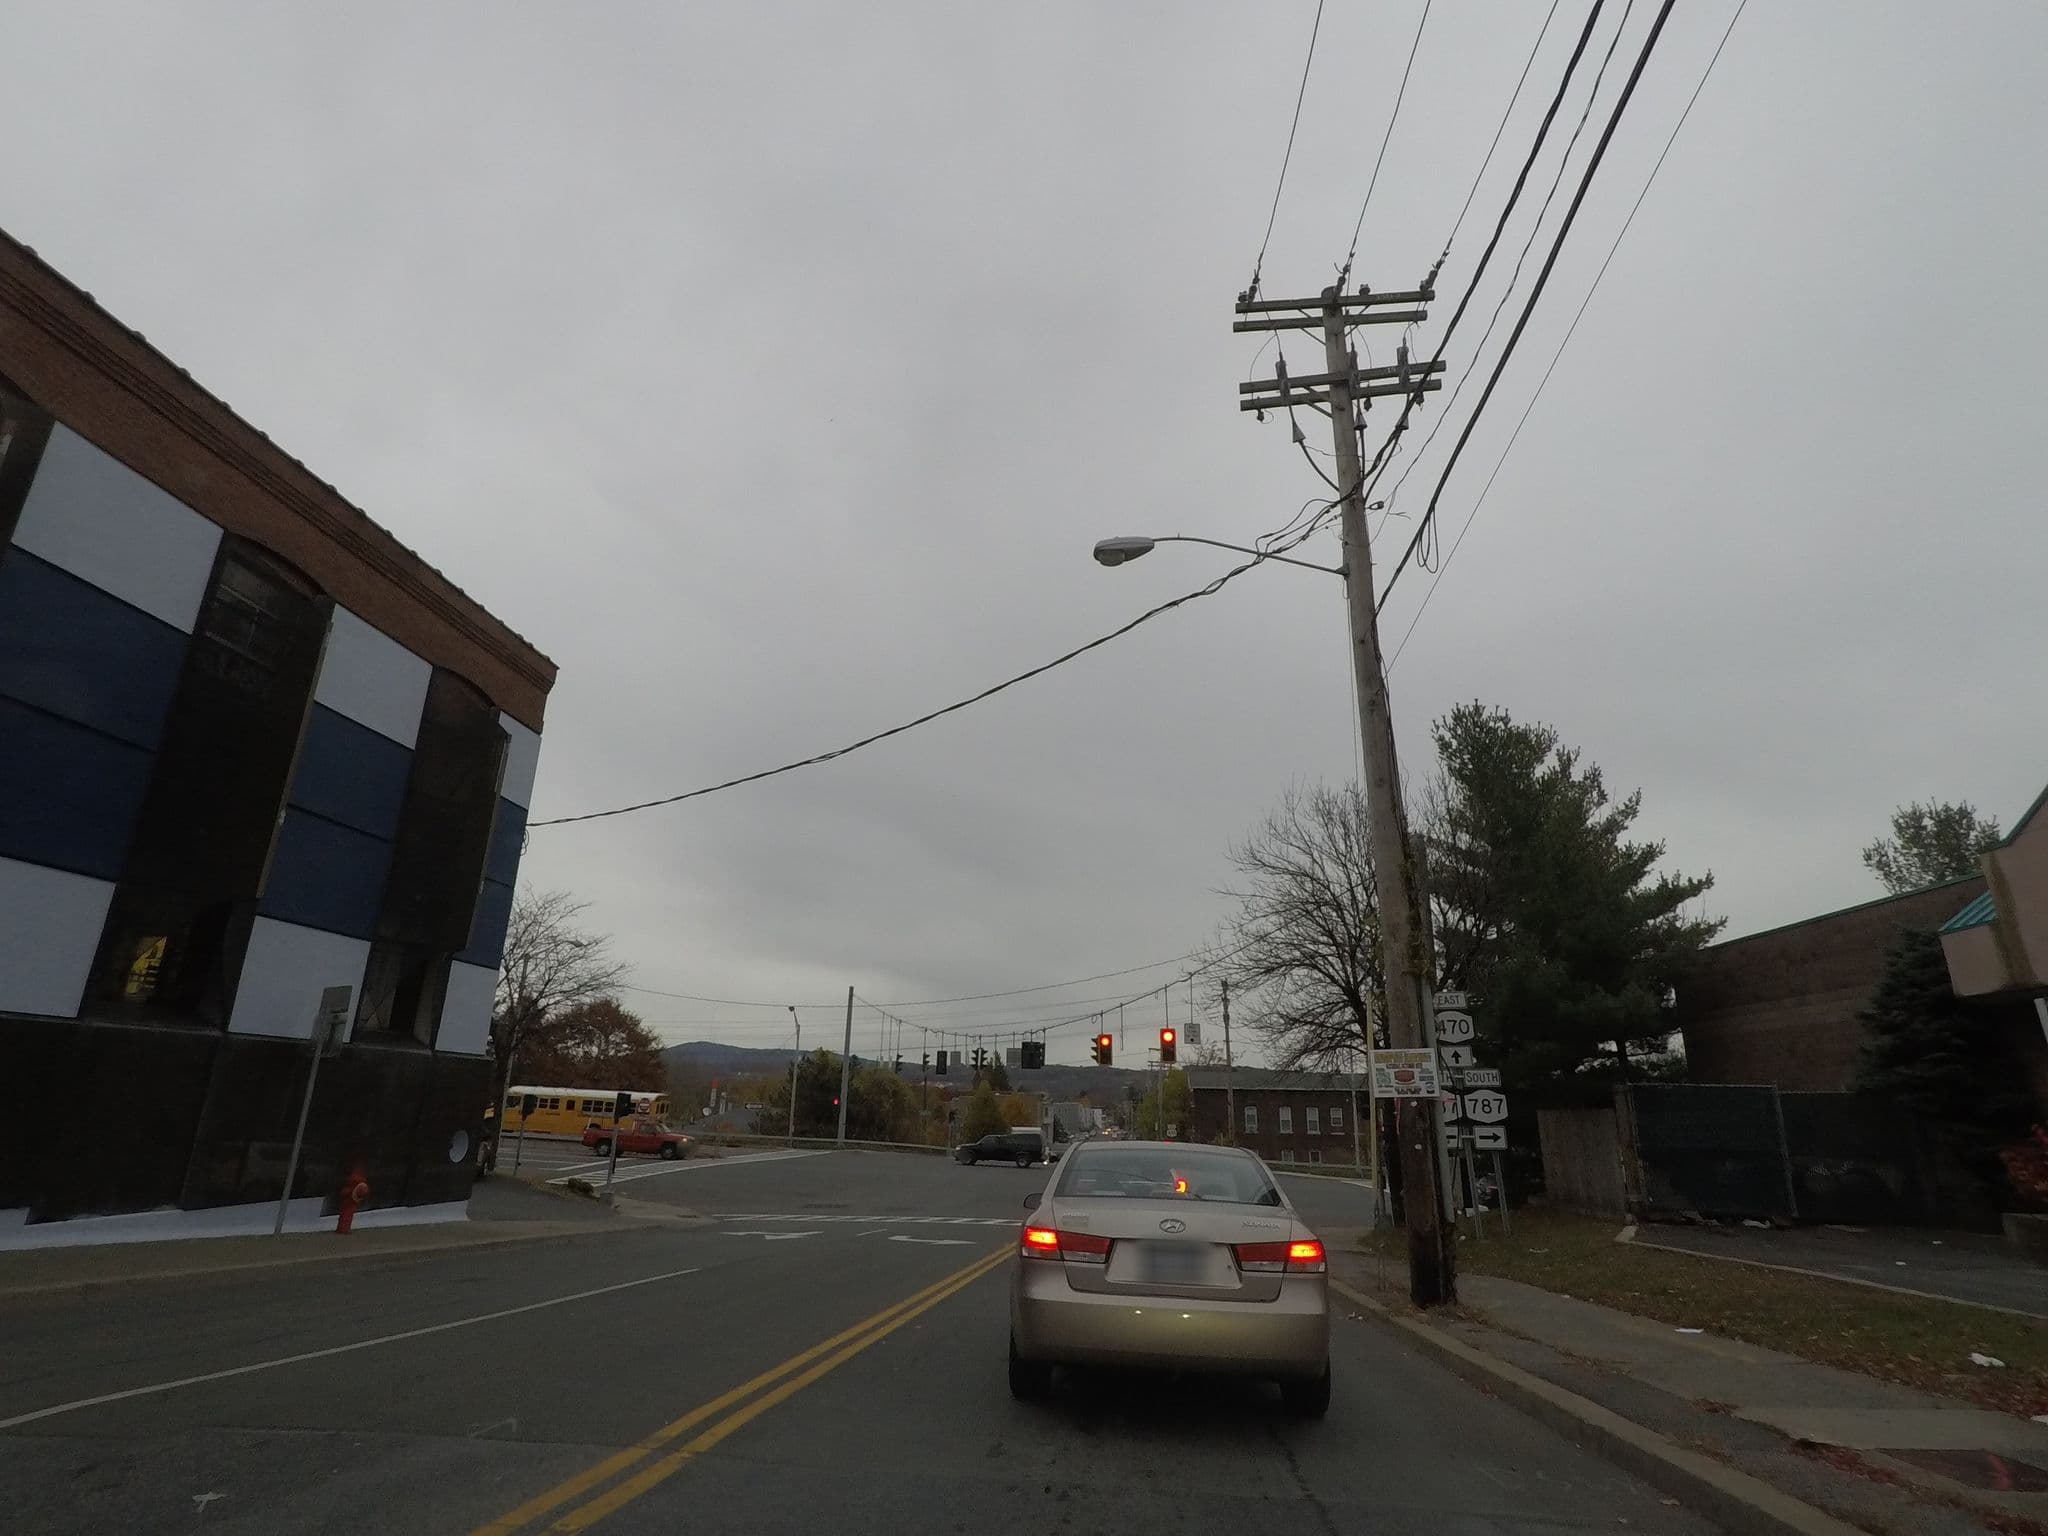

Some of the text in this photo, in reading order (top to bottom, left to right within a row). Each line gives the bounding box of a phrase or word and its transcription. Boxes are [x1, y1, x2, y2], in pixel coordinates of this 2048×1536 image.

[1438, 995, 1460, 1005] EAST
[1435, 1019, 1470, 1035] 470
[1466, 1072, 1498, 1083] SOUTH
[1468, 1098, 1503, 1114] 787
